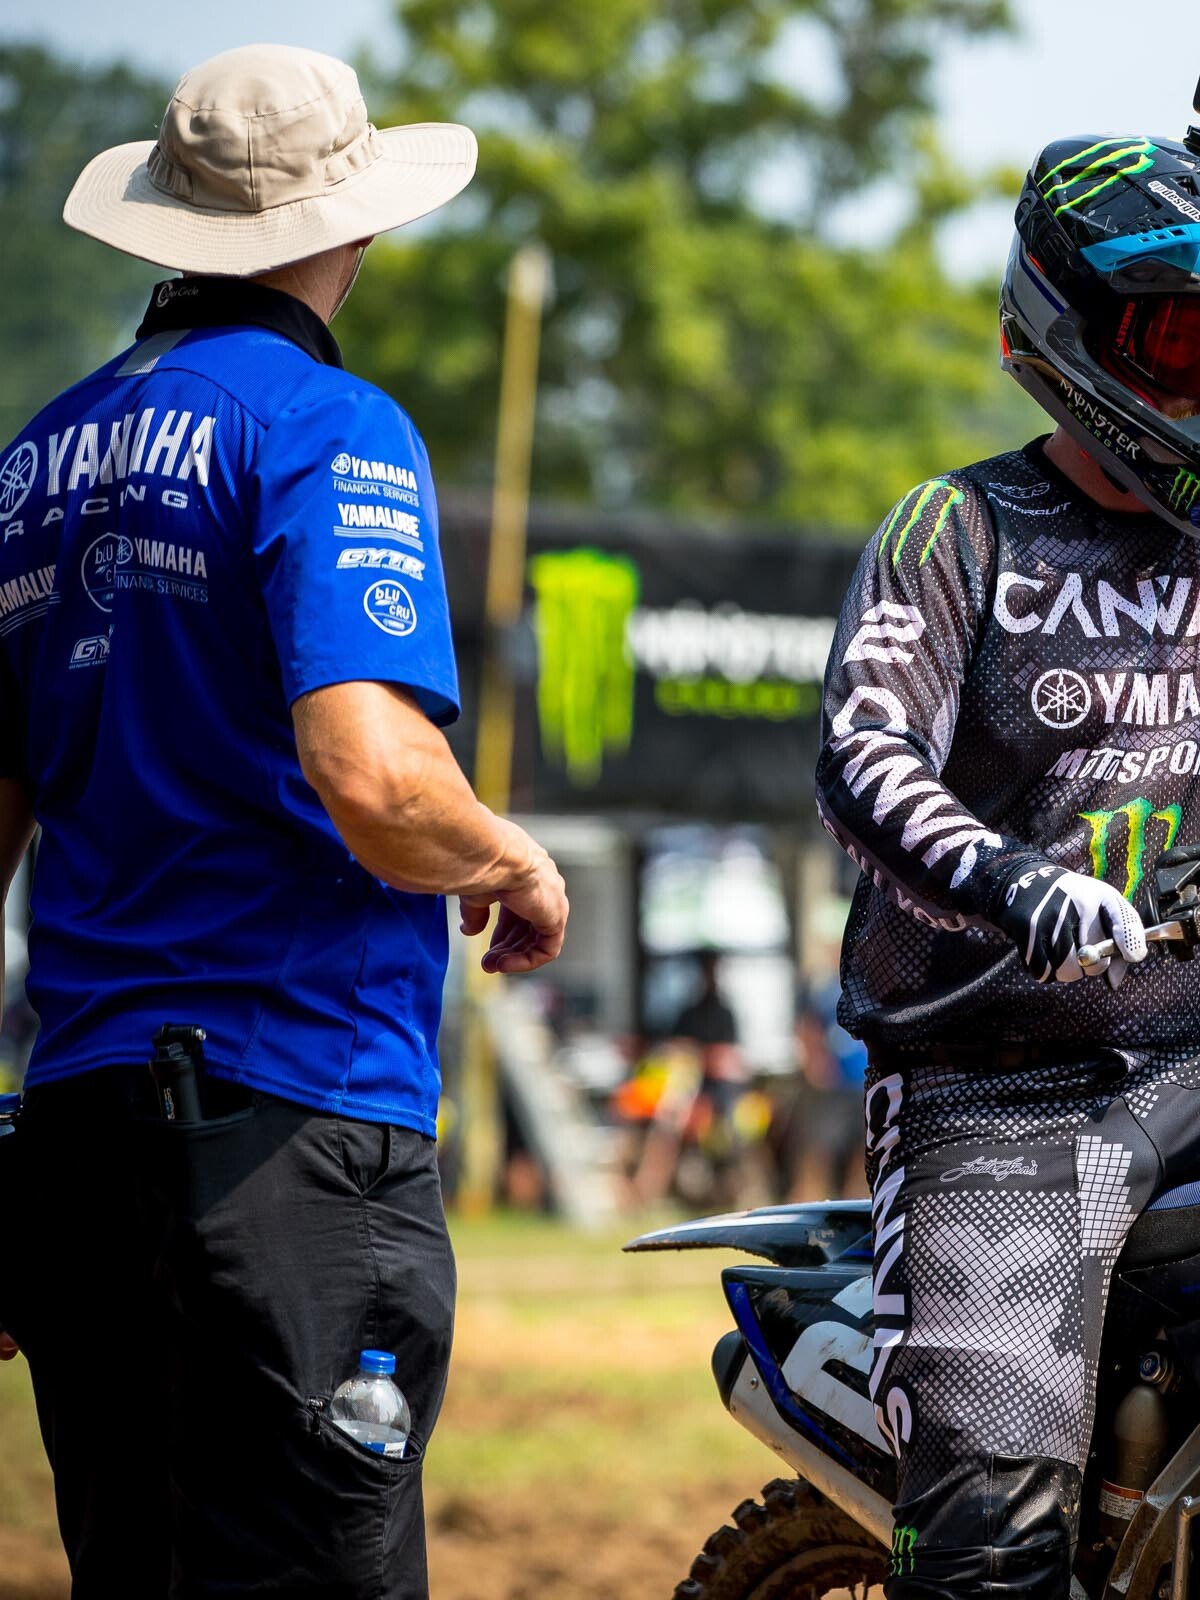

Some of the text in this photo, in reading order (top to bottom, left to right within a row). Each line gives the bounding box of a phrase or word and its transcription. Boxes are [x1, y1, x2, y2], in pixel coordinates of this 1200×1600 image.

[1060, 379, 1140, 460] MONSTER
[351, 456, 418, 492] YAMAHA
[333, 479, 420, 508] FINANCIAL SERVICES
[337, 502, 420, 538] YAMALUBE
[134, 537, 208, 579] YAMAHA
